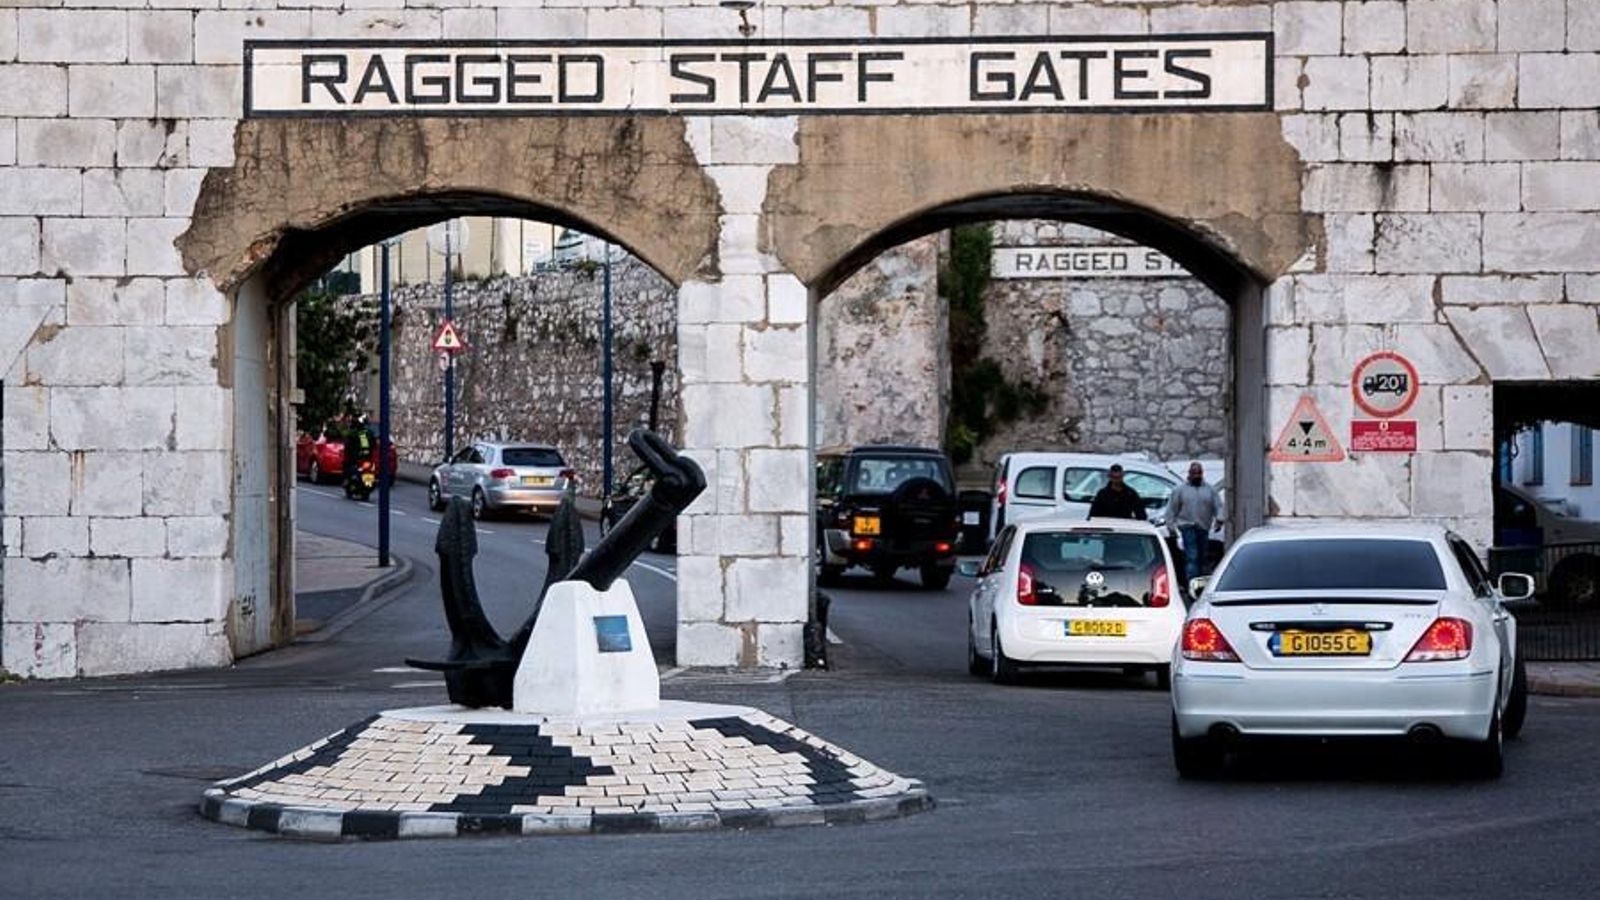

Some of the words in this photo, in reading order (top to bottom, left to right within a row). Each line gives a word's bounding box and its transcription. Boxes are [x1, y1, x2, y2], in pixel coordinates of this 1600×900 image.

[301, 53, 604, 104] RAGGED
[669, 51, 904, 103] STAFF
[969, 49, 1212, 101] GATES
[1015, 252, 1128, 271] RAGGED
